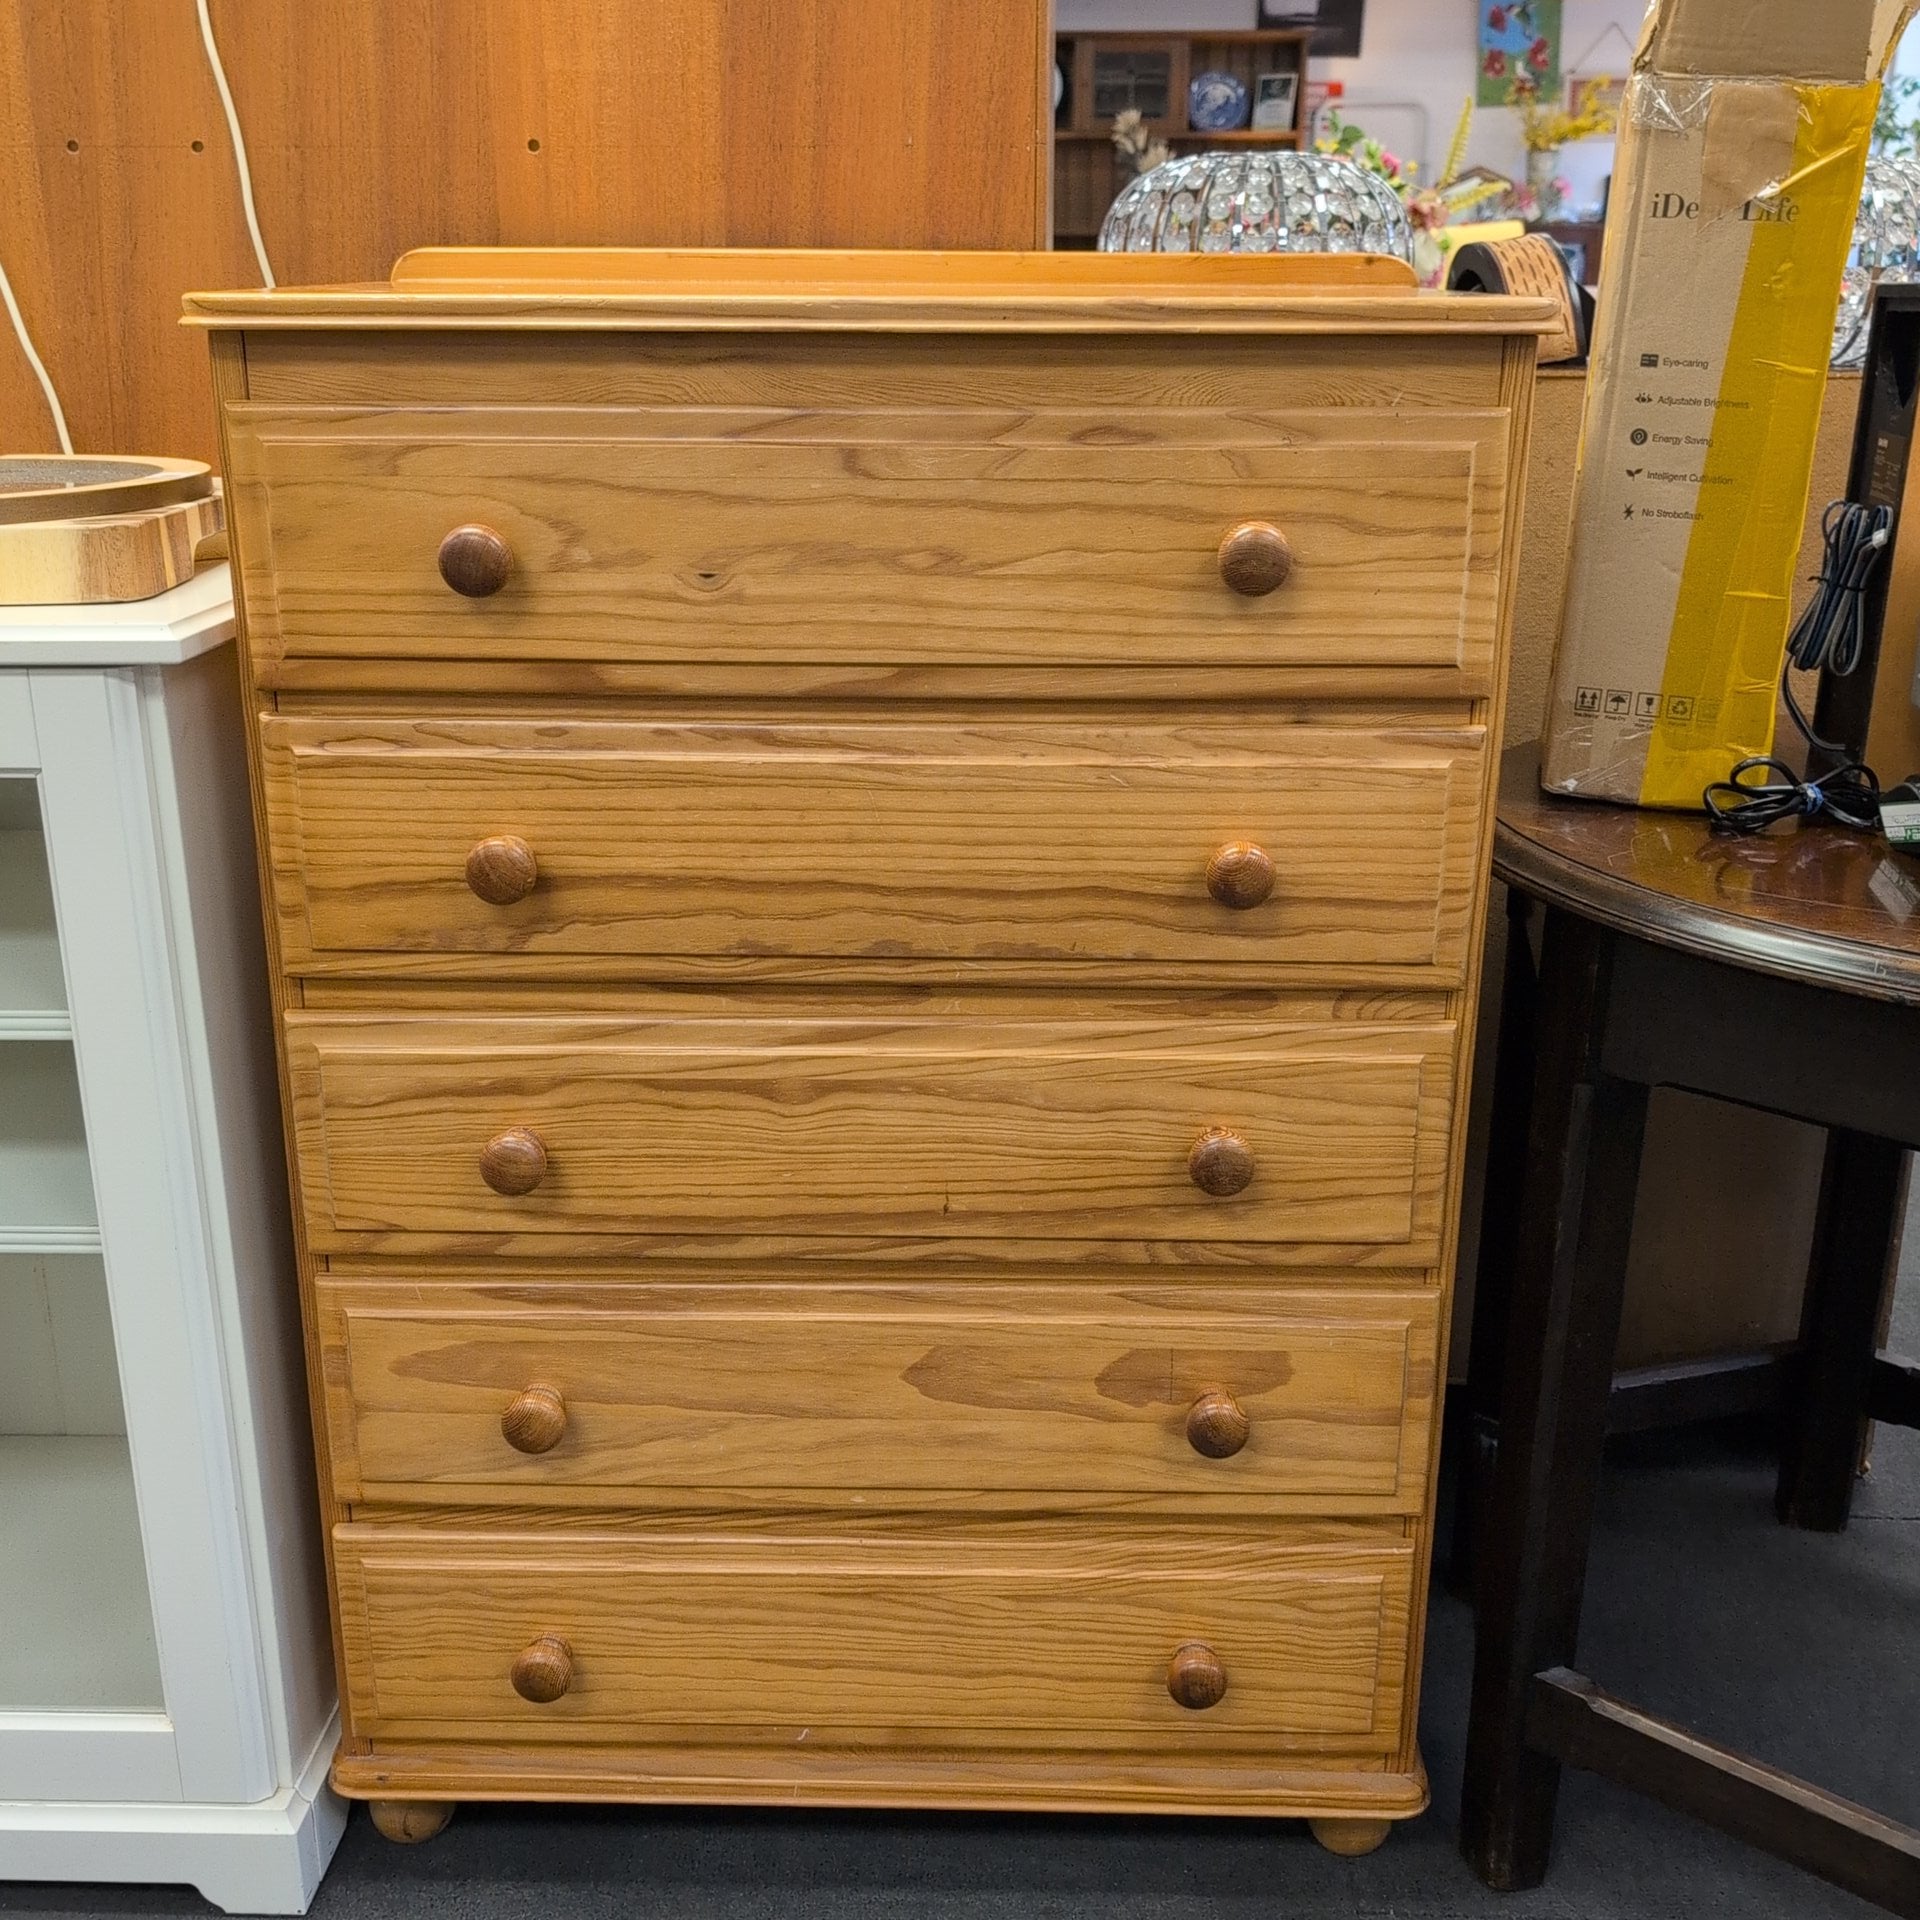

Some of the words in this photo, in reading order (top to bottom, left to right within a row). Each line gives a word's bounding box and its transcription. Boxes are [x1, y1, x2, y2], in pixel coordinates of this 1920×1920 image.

[1738, 196, 1799, 222] Life
[1663, 357, 1709, 370] Eye-caring
[1657, 396, 1702, 408] Adjustable
[1652, 434, 1683, 445] Energy
[1684, 436, 1714, 448] Saving
[1647, 471, 1688, 483] Intelligent
[1641, 508, 1655, 517] No
